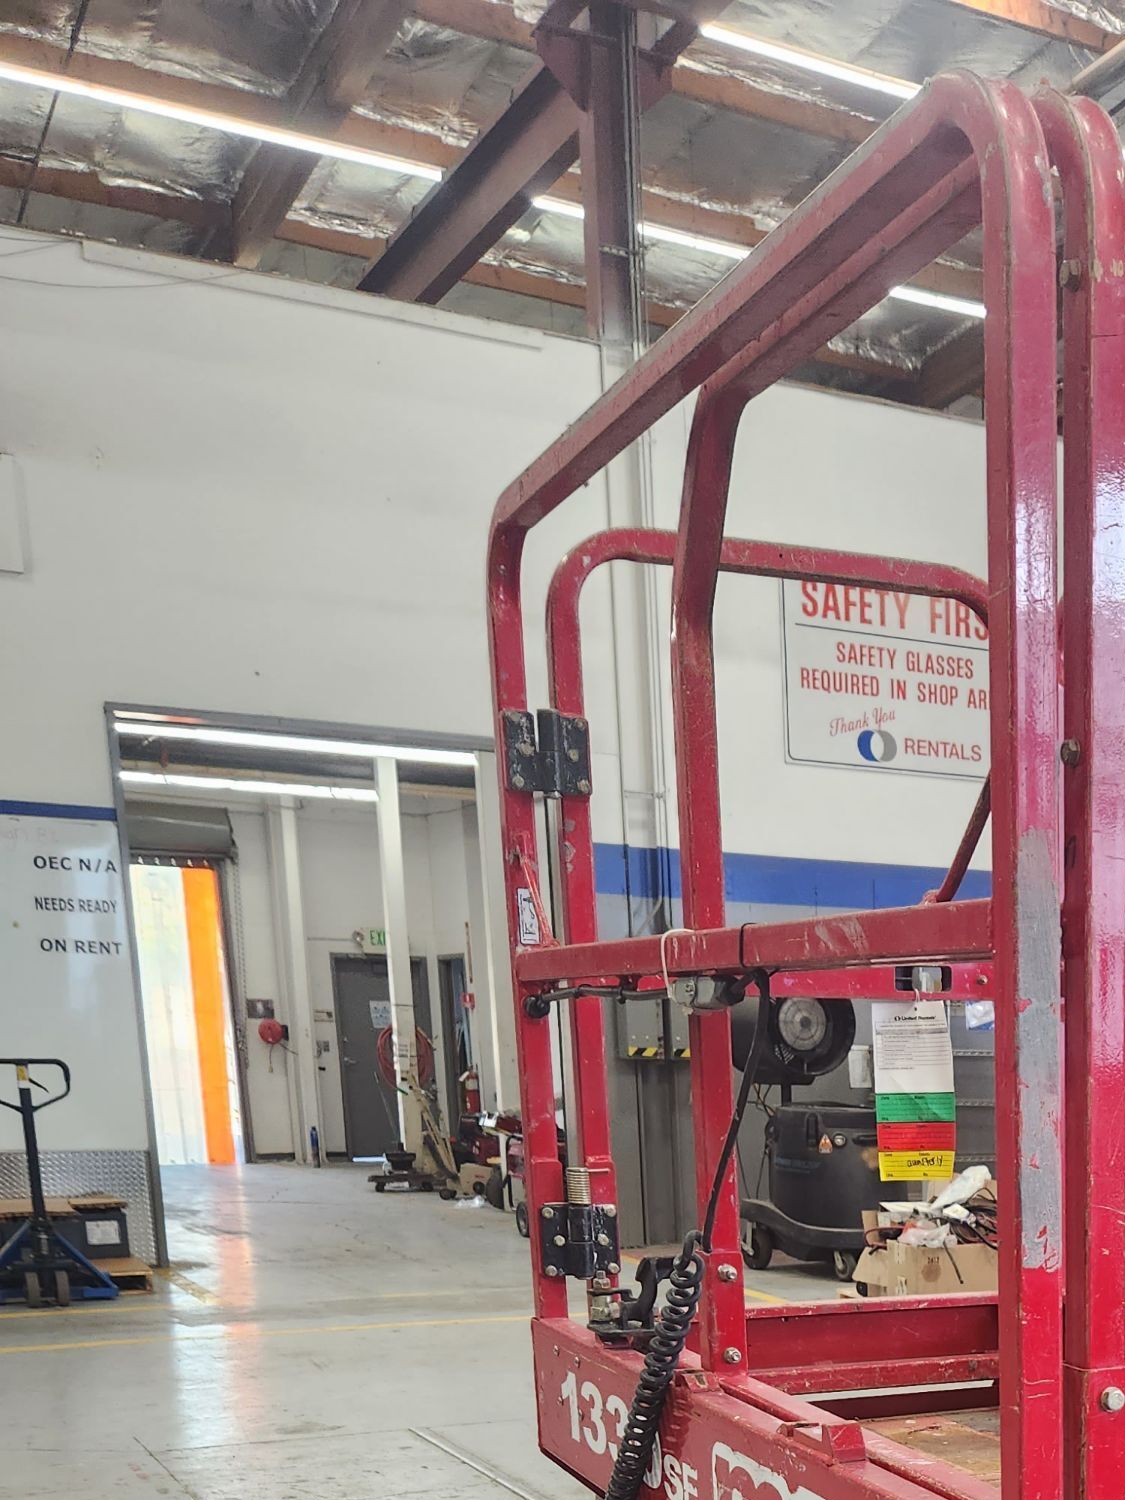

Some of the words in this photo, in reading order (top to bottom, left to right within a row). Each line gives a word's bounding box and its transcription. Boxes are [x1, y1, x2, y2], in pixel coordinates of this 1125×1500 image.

[801, 580, 910, 629] SAFETY
[836, 641, 896, 670] SAFETY
[906, 650, 974, 680] GLASSES
[800, 666, 880, 697] REQUIRED
[890, 678, 907, 700] IN
[917, 681, 958, 706] SHOP
[829, 712, 869, 737] Thank
[872, 706, 896, 732] You
[904, 737, 982, 762] RENTALS
[33, 855, 72, 871] OEC
[79, 858, 117, 873] N/A
[34, 896, 75, 912] NEEDS
[79, 899, 117, 914] READY
[40, 938, 67, 953] ON
[74, 940, 122, 955] RENT
